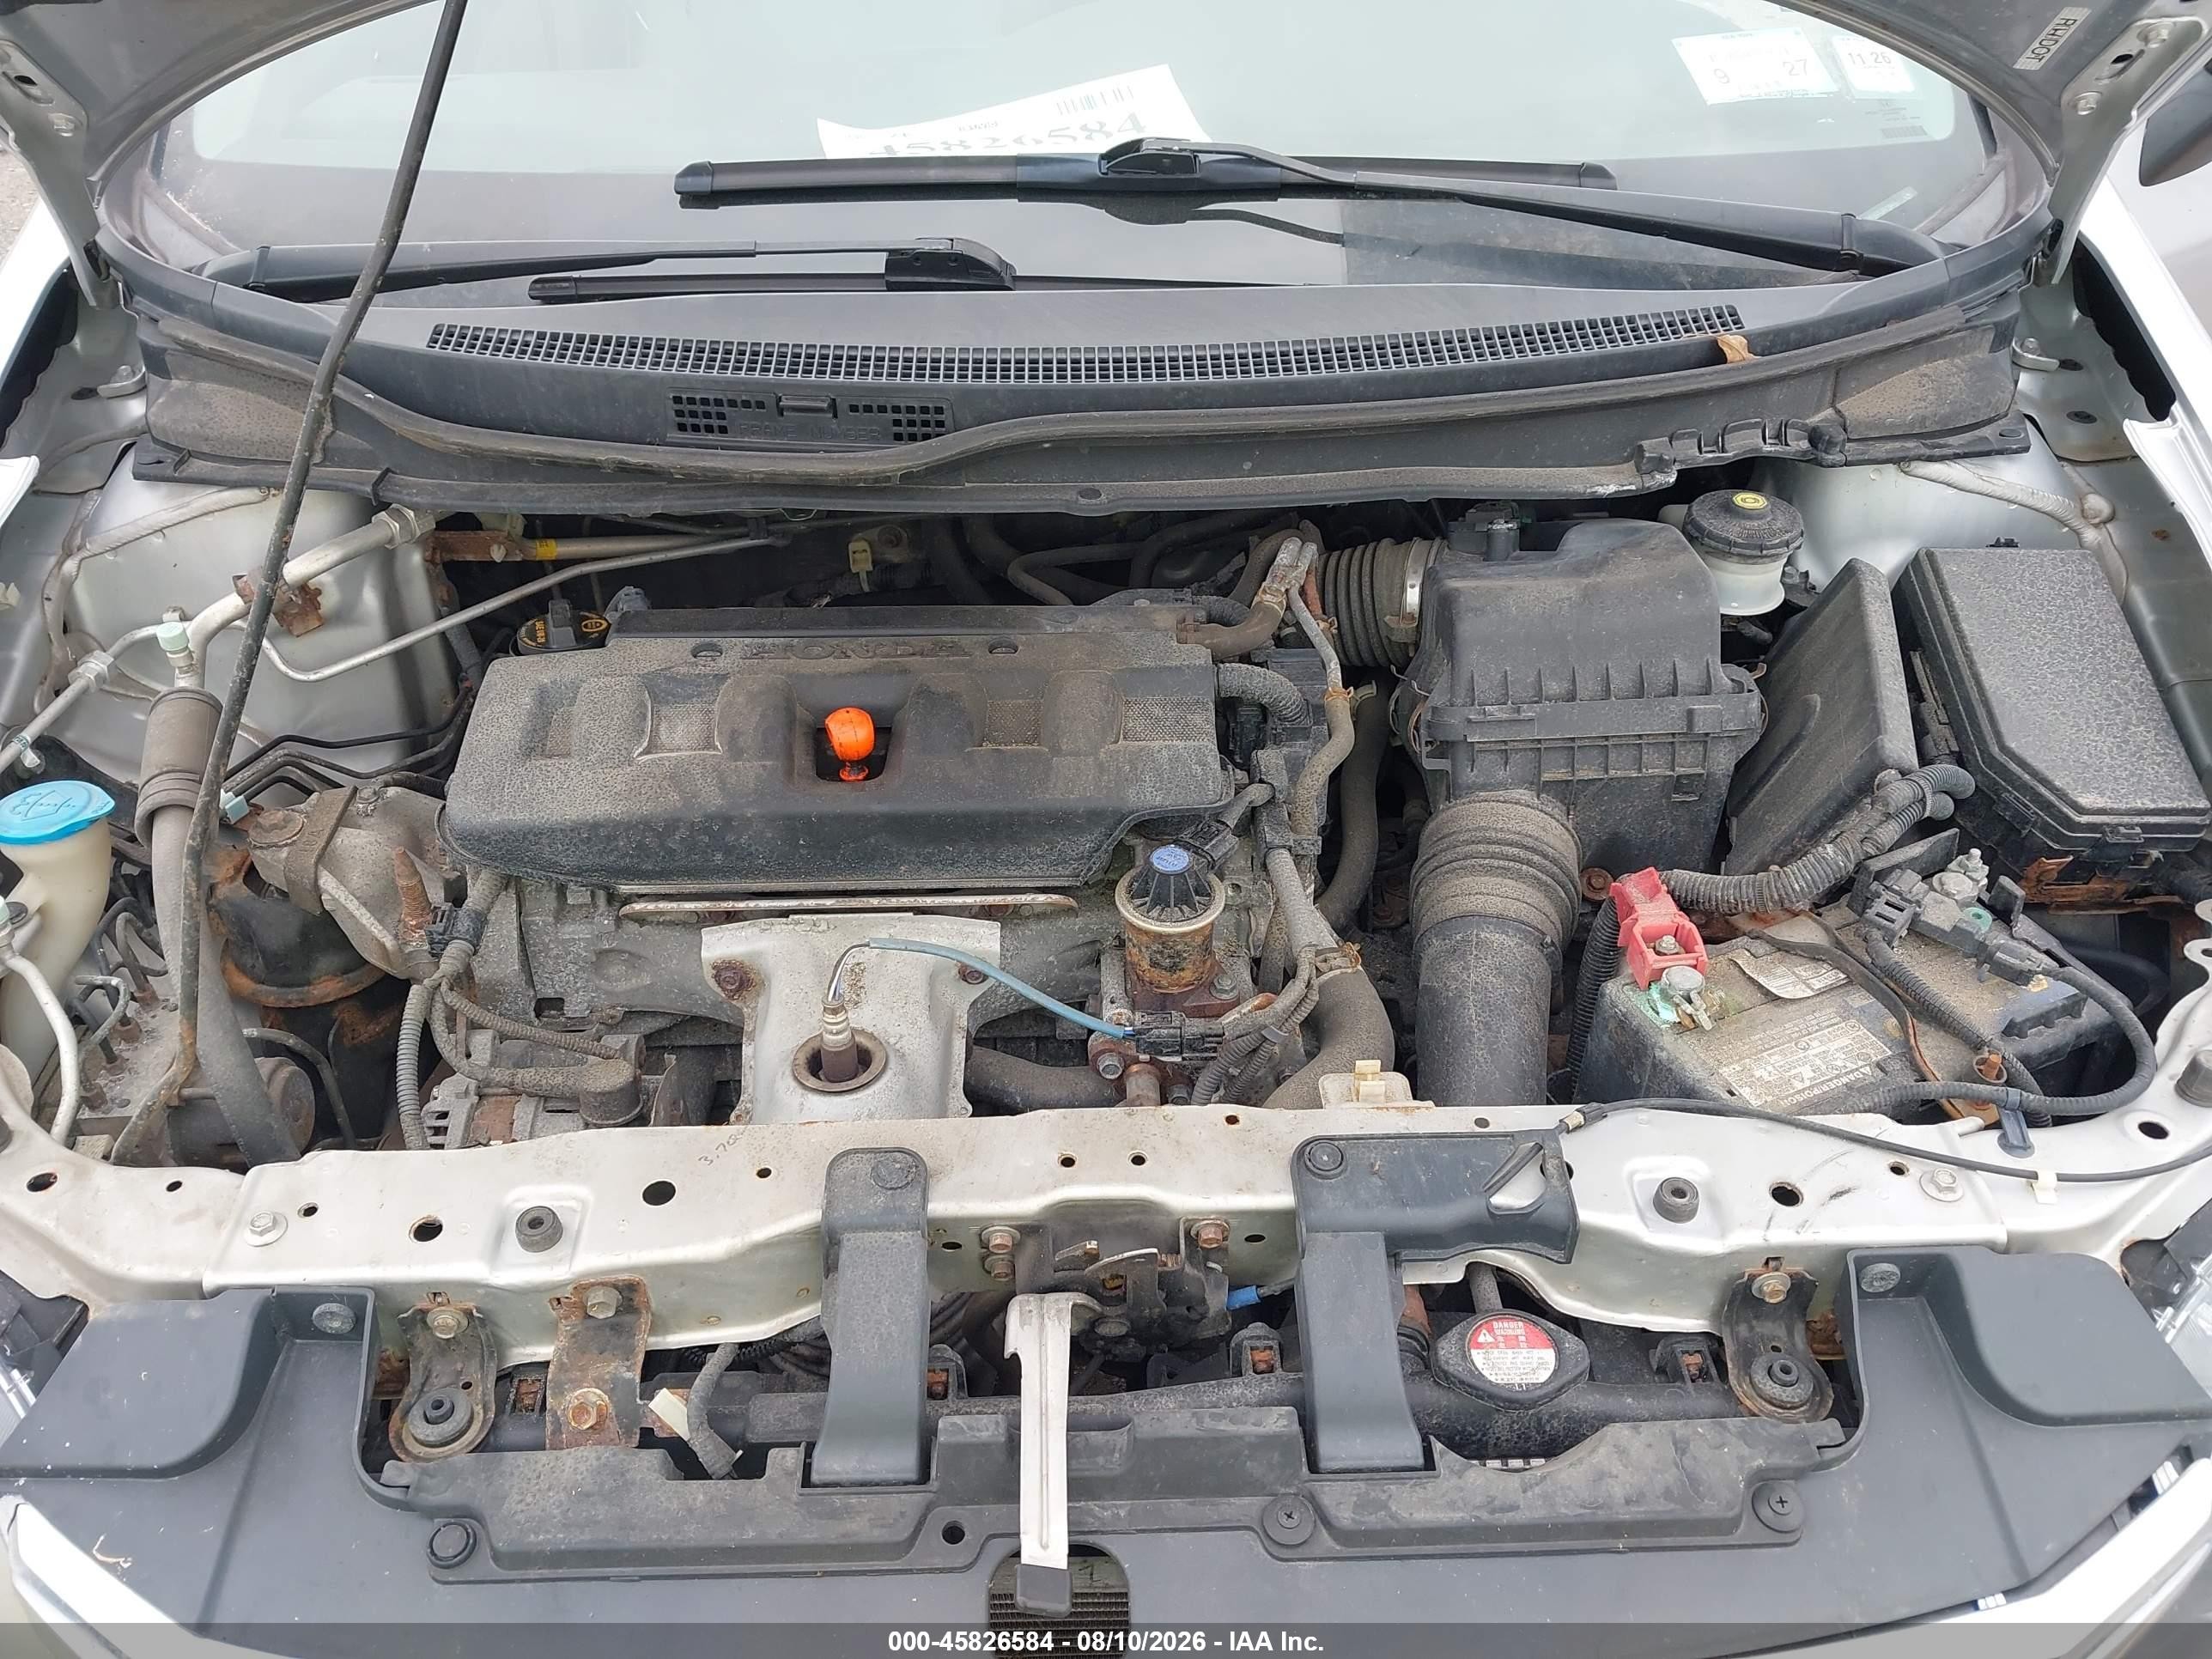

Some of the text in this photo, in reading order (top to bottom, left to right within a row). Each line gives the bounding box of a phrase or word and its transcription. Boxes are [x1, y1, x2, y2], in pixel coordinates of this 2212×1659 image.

[1869, 51, 1892, 64] 26
[1712, 58, 1808, 85] 9 27
[868, 112, 1147, 157] 45826584
[738, 422, 882, 441] FRAME NUMBER
